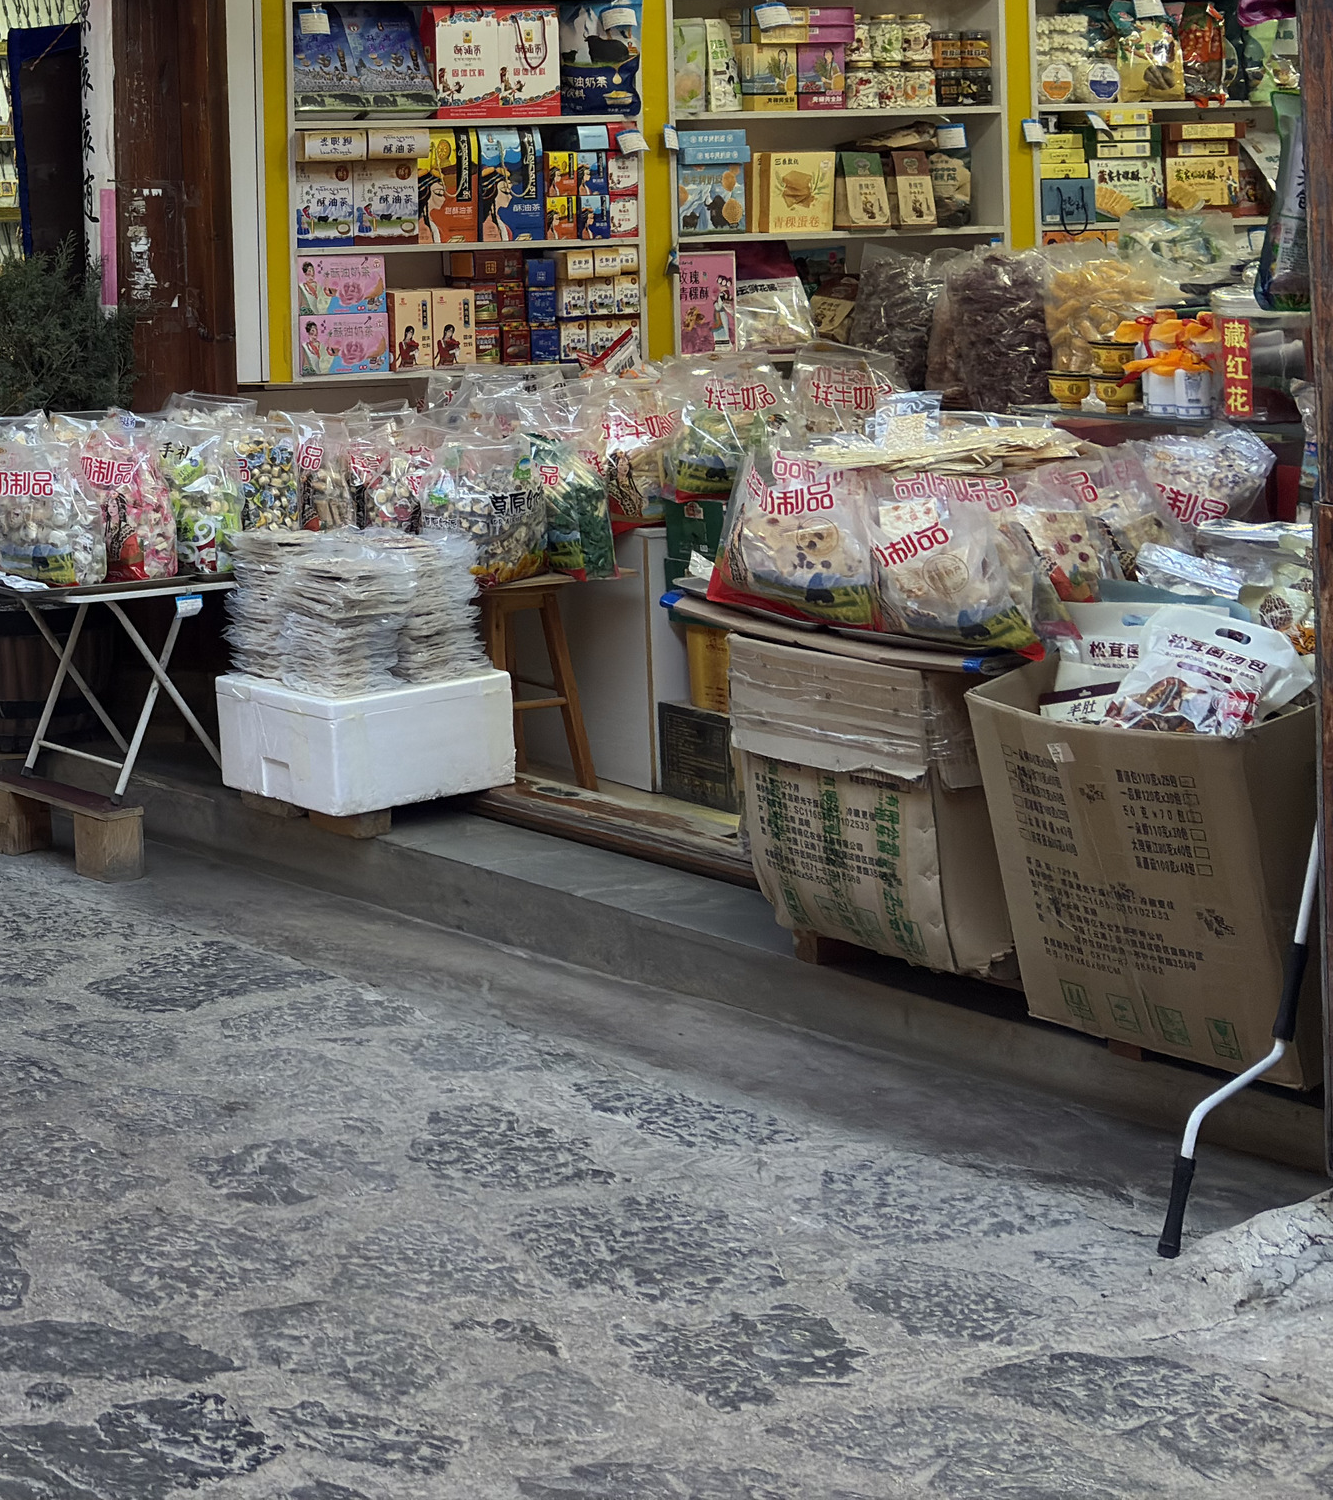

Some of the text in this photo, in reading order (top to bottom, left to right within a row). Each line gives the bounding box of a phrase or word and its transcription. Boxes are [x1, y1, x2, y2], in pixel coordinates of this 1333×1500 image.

[513, 203, 541, 213] 酥油茶
[773, 215, 820, 229] 青稞蛋卷
[1223, 321, 1250, 413] 藏红花
[1167, 633, 1269, 674] 松茸菌汤包
